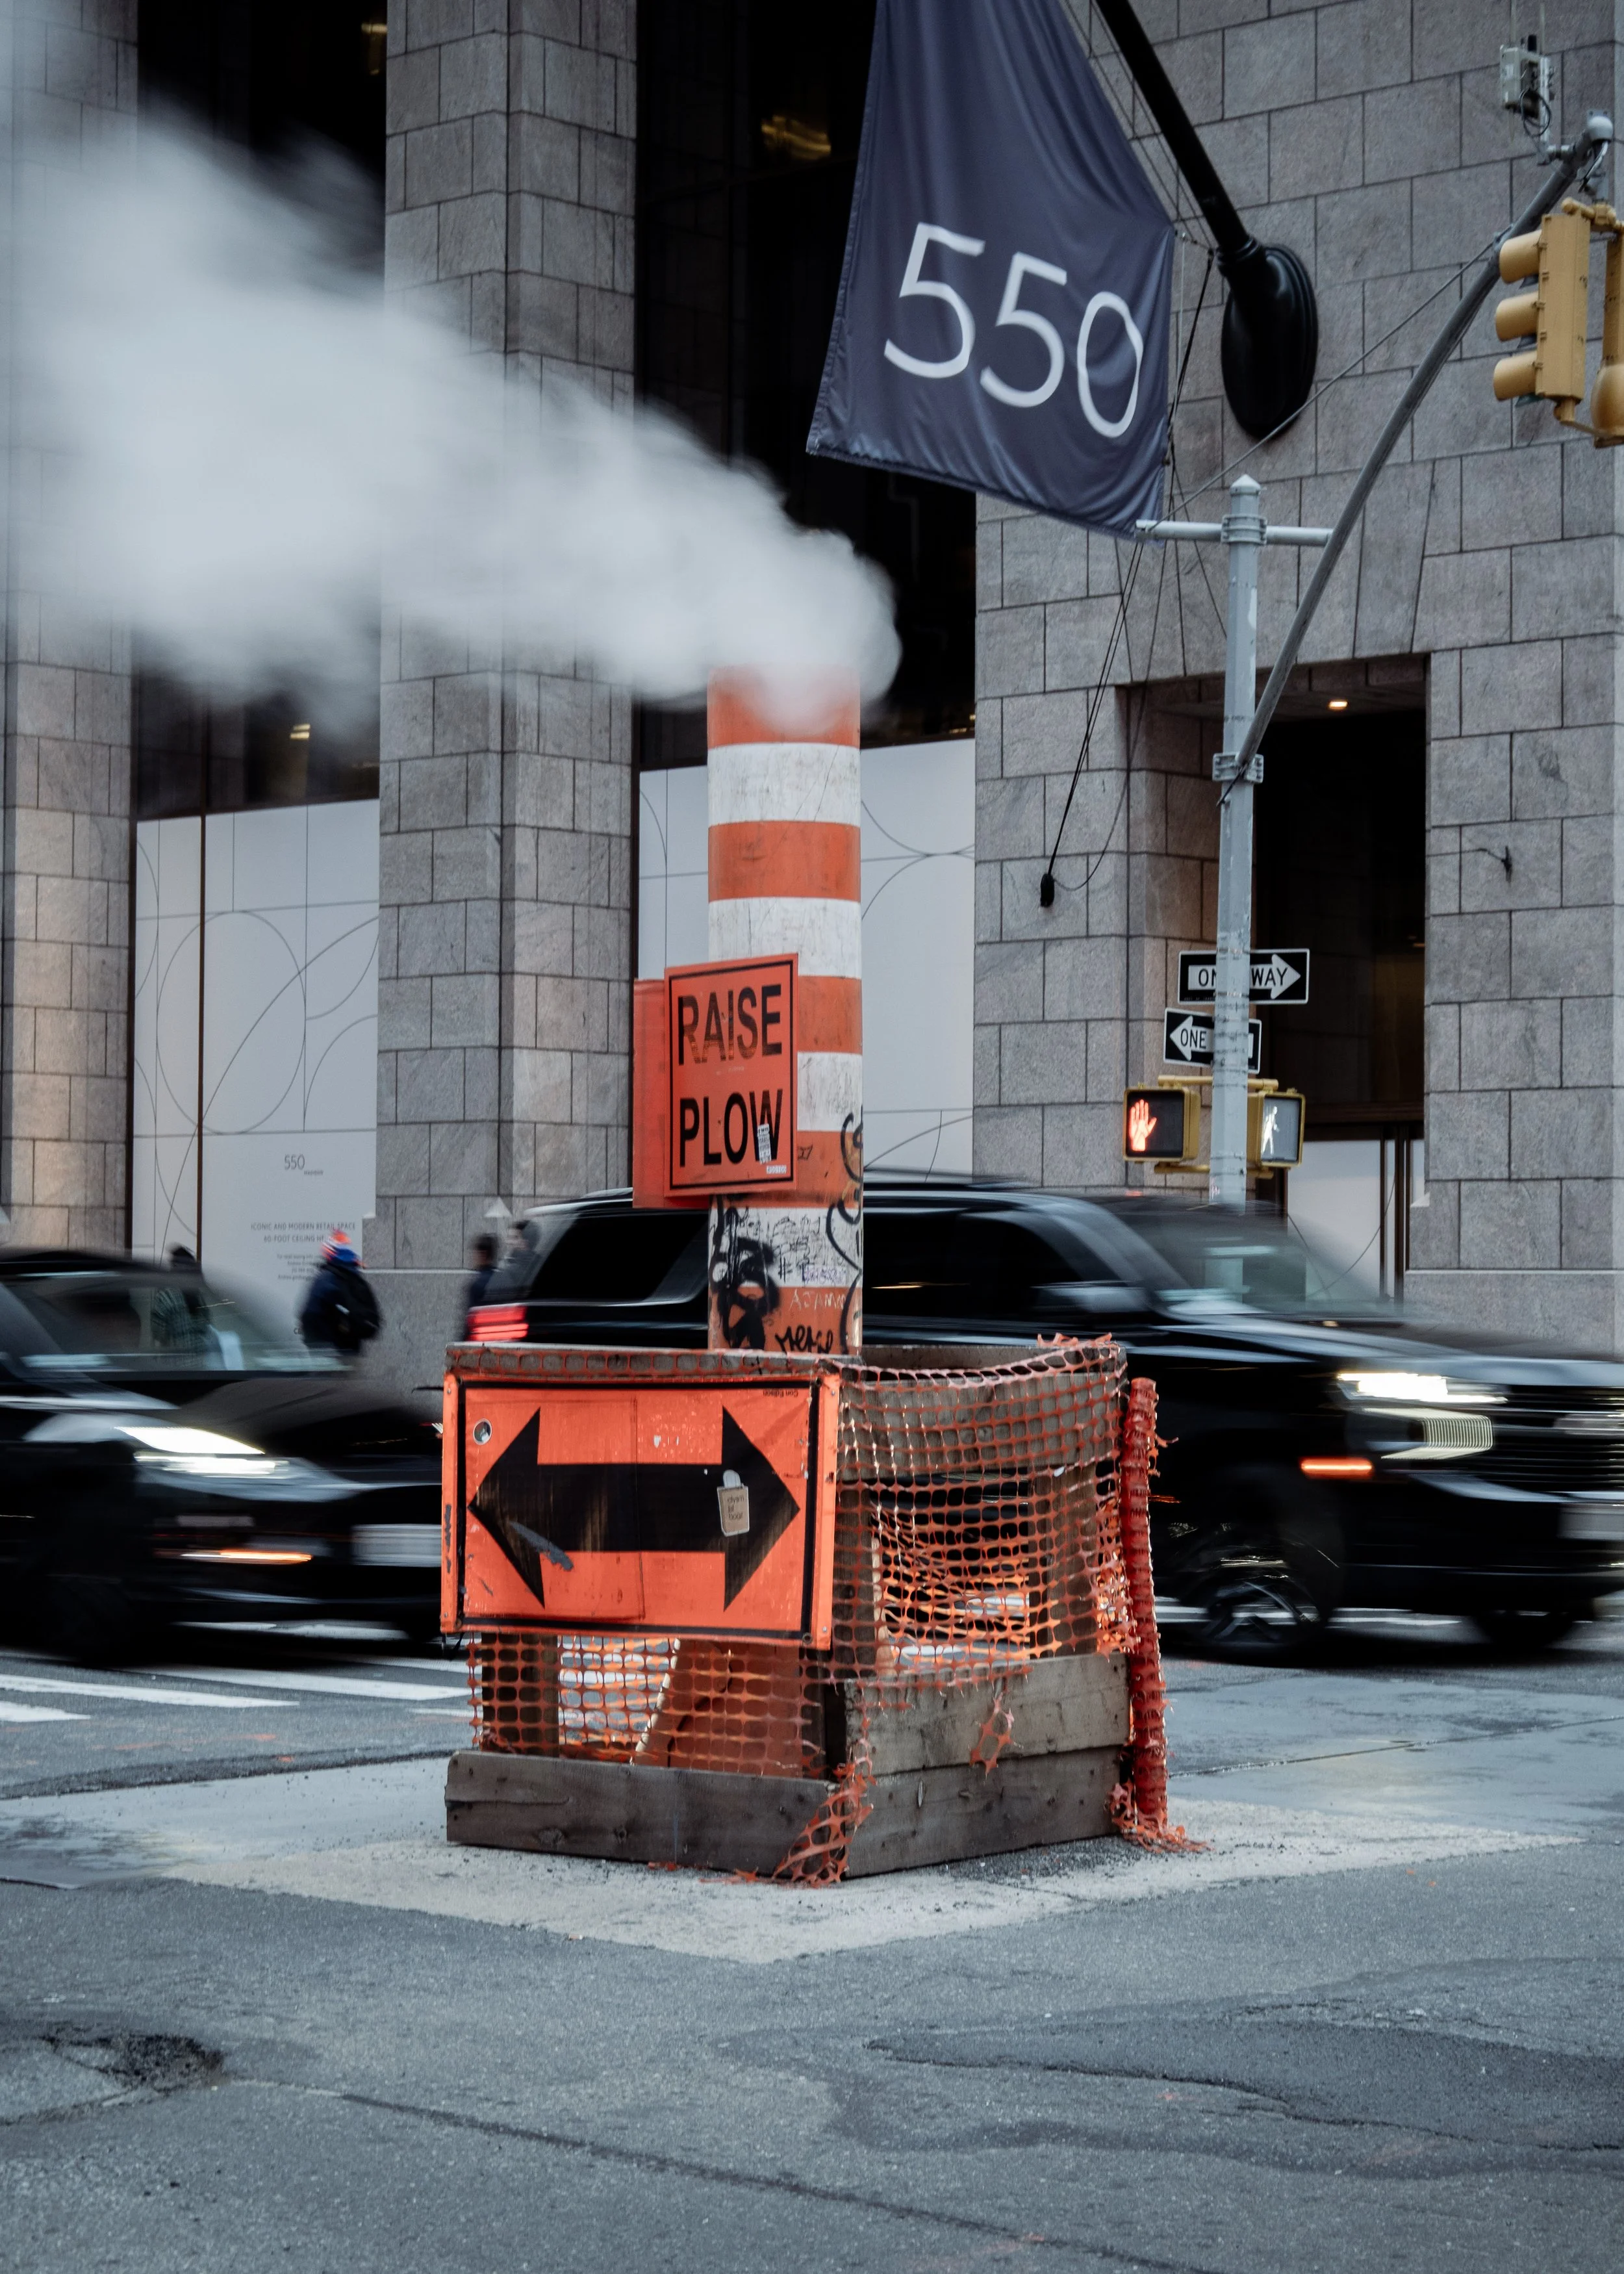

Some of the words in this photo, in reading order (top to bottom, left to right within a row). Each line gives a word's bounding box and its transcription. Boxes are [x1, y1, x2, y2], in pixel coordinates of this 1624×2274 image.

[883, 222, 1144, 439] 550
[1199, 968, 1217, 987] ON
[1251, 967, 1288, 986] WAY
[678, 984, 782, 1066] RAISE
[1180, 1028, 1207, 1049] ONE
[679, 1088, 783, 1167] PLOW
[284, 1153, 305, 1171] 550
[251, 1221, 272, 1231] ICONIC
[273, 1221, 286, 1231] AND
[288, 1221, 314, 1231] MODERN
[292, 1234, 315, 1243] CEILING
[763, 1389, 784, 1398] Edison
